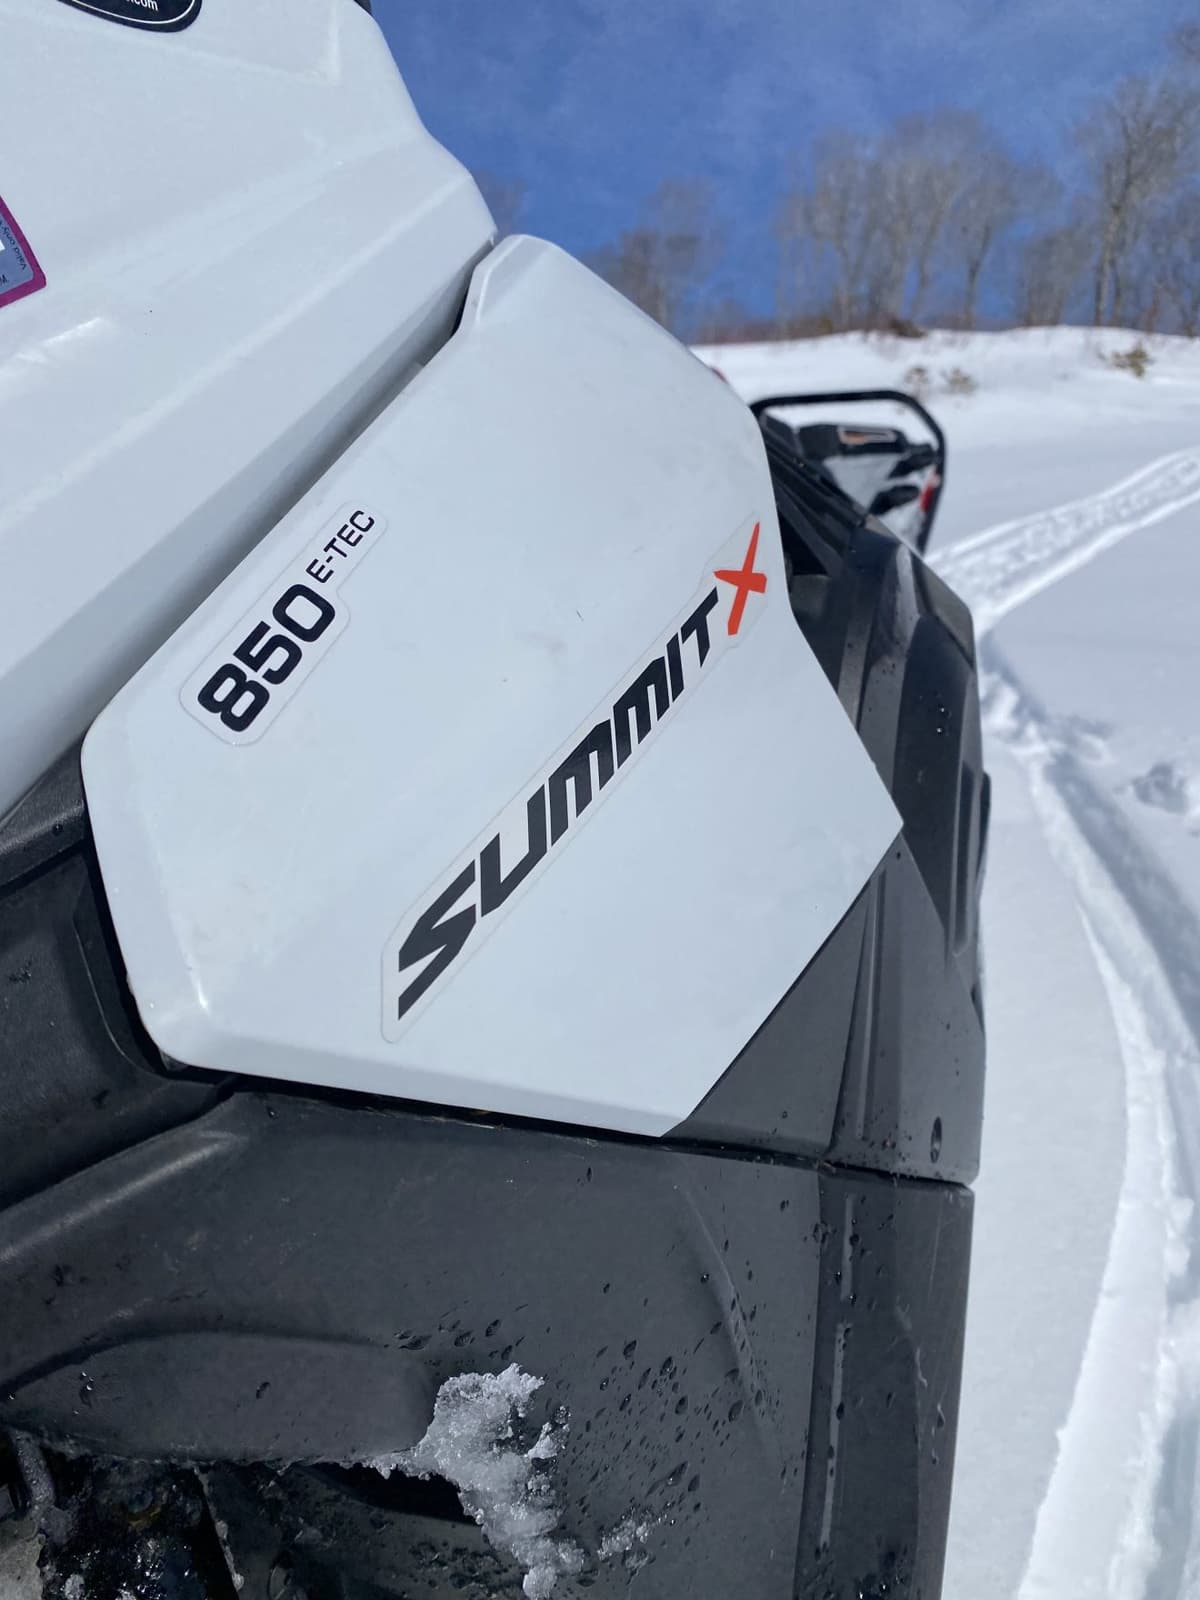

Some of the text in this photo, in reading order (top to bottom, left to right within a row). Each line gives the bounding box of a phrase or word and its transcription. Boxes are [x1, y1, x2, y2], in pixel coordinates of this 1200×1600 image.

[197, 510, 375, 733] 850 E-TEC
[398, 522, 768, 1020] SUMMIT X
